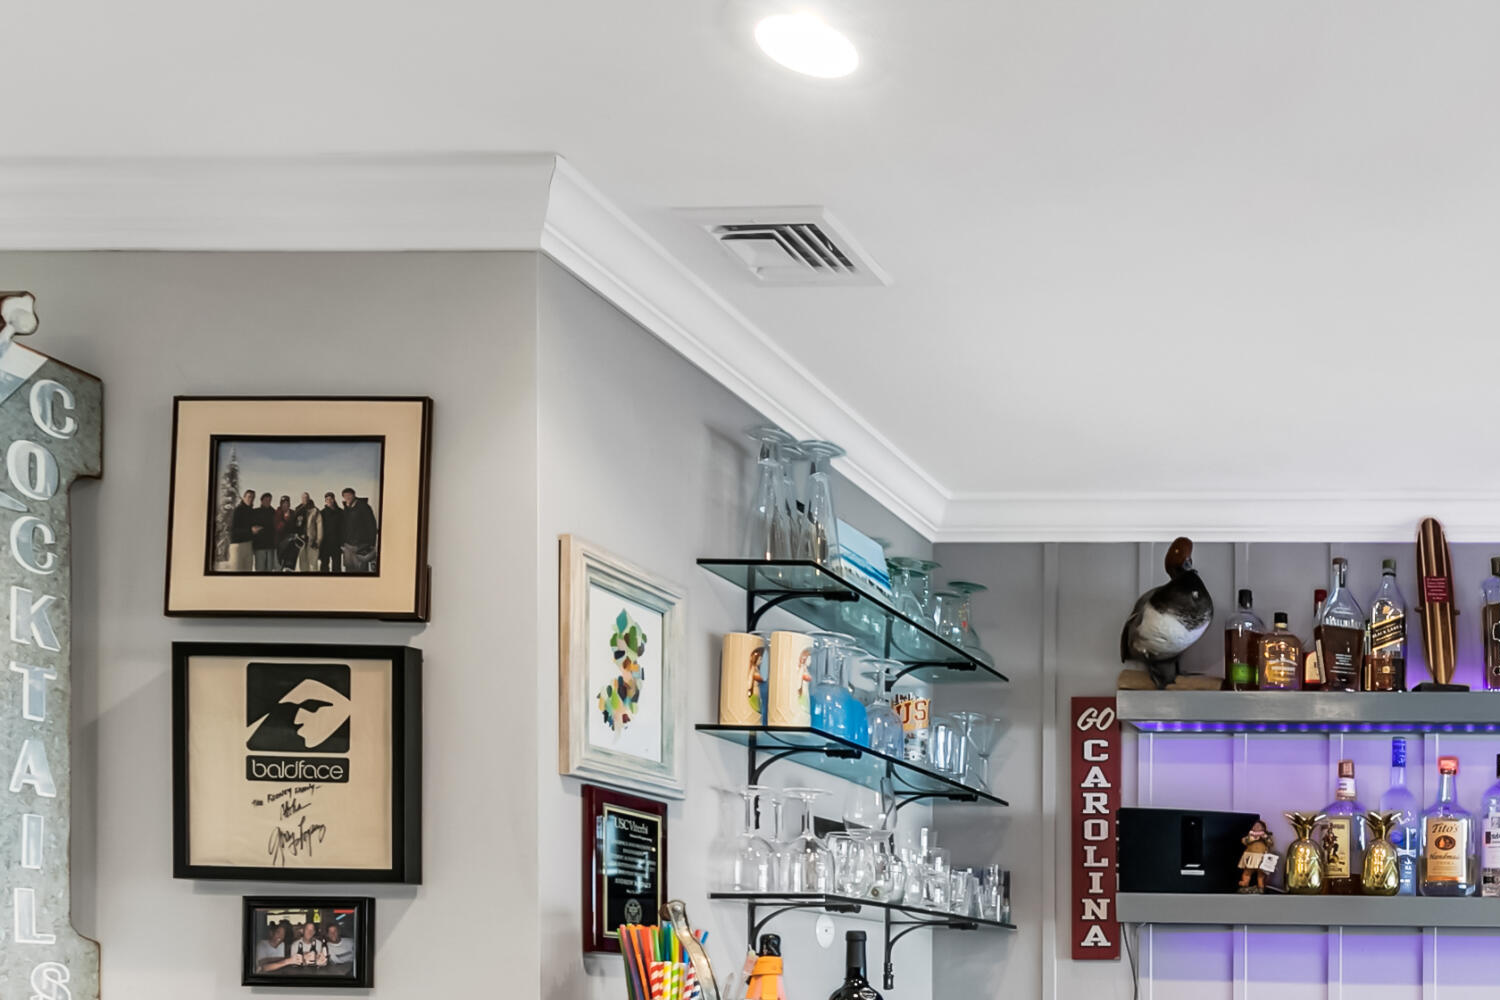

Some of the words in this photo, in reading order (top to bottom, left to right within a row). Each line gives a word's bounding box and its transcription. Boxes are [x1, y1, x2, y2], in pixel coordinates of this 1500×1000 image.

[1077, 706, 1115, 731] GO
[252, 759, 344, 780] baldface
[1431, 823, 1458, 834] Tito's
[1080, 739, 1112, 947] CAROLINA
